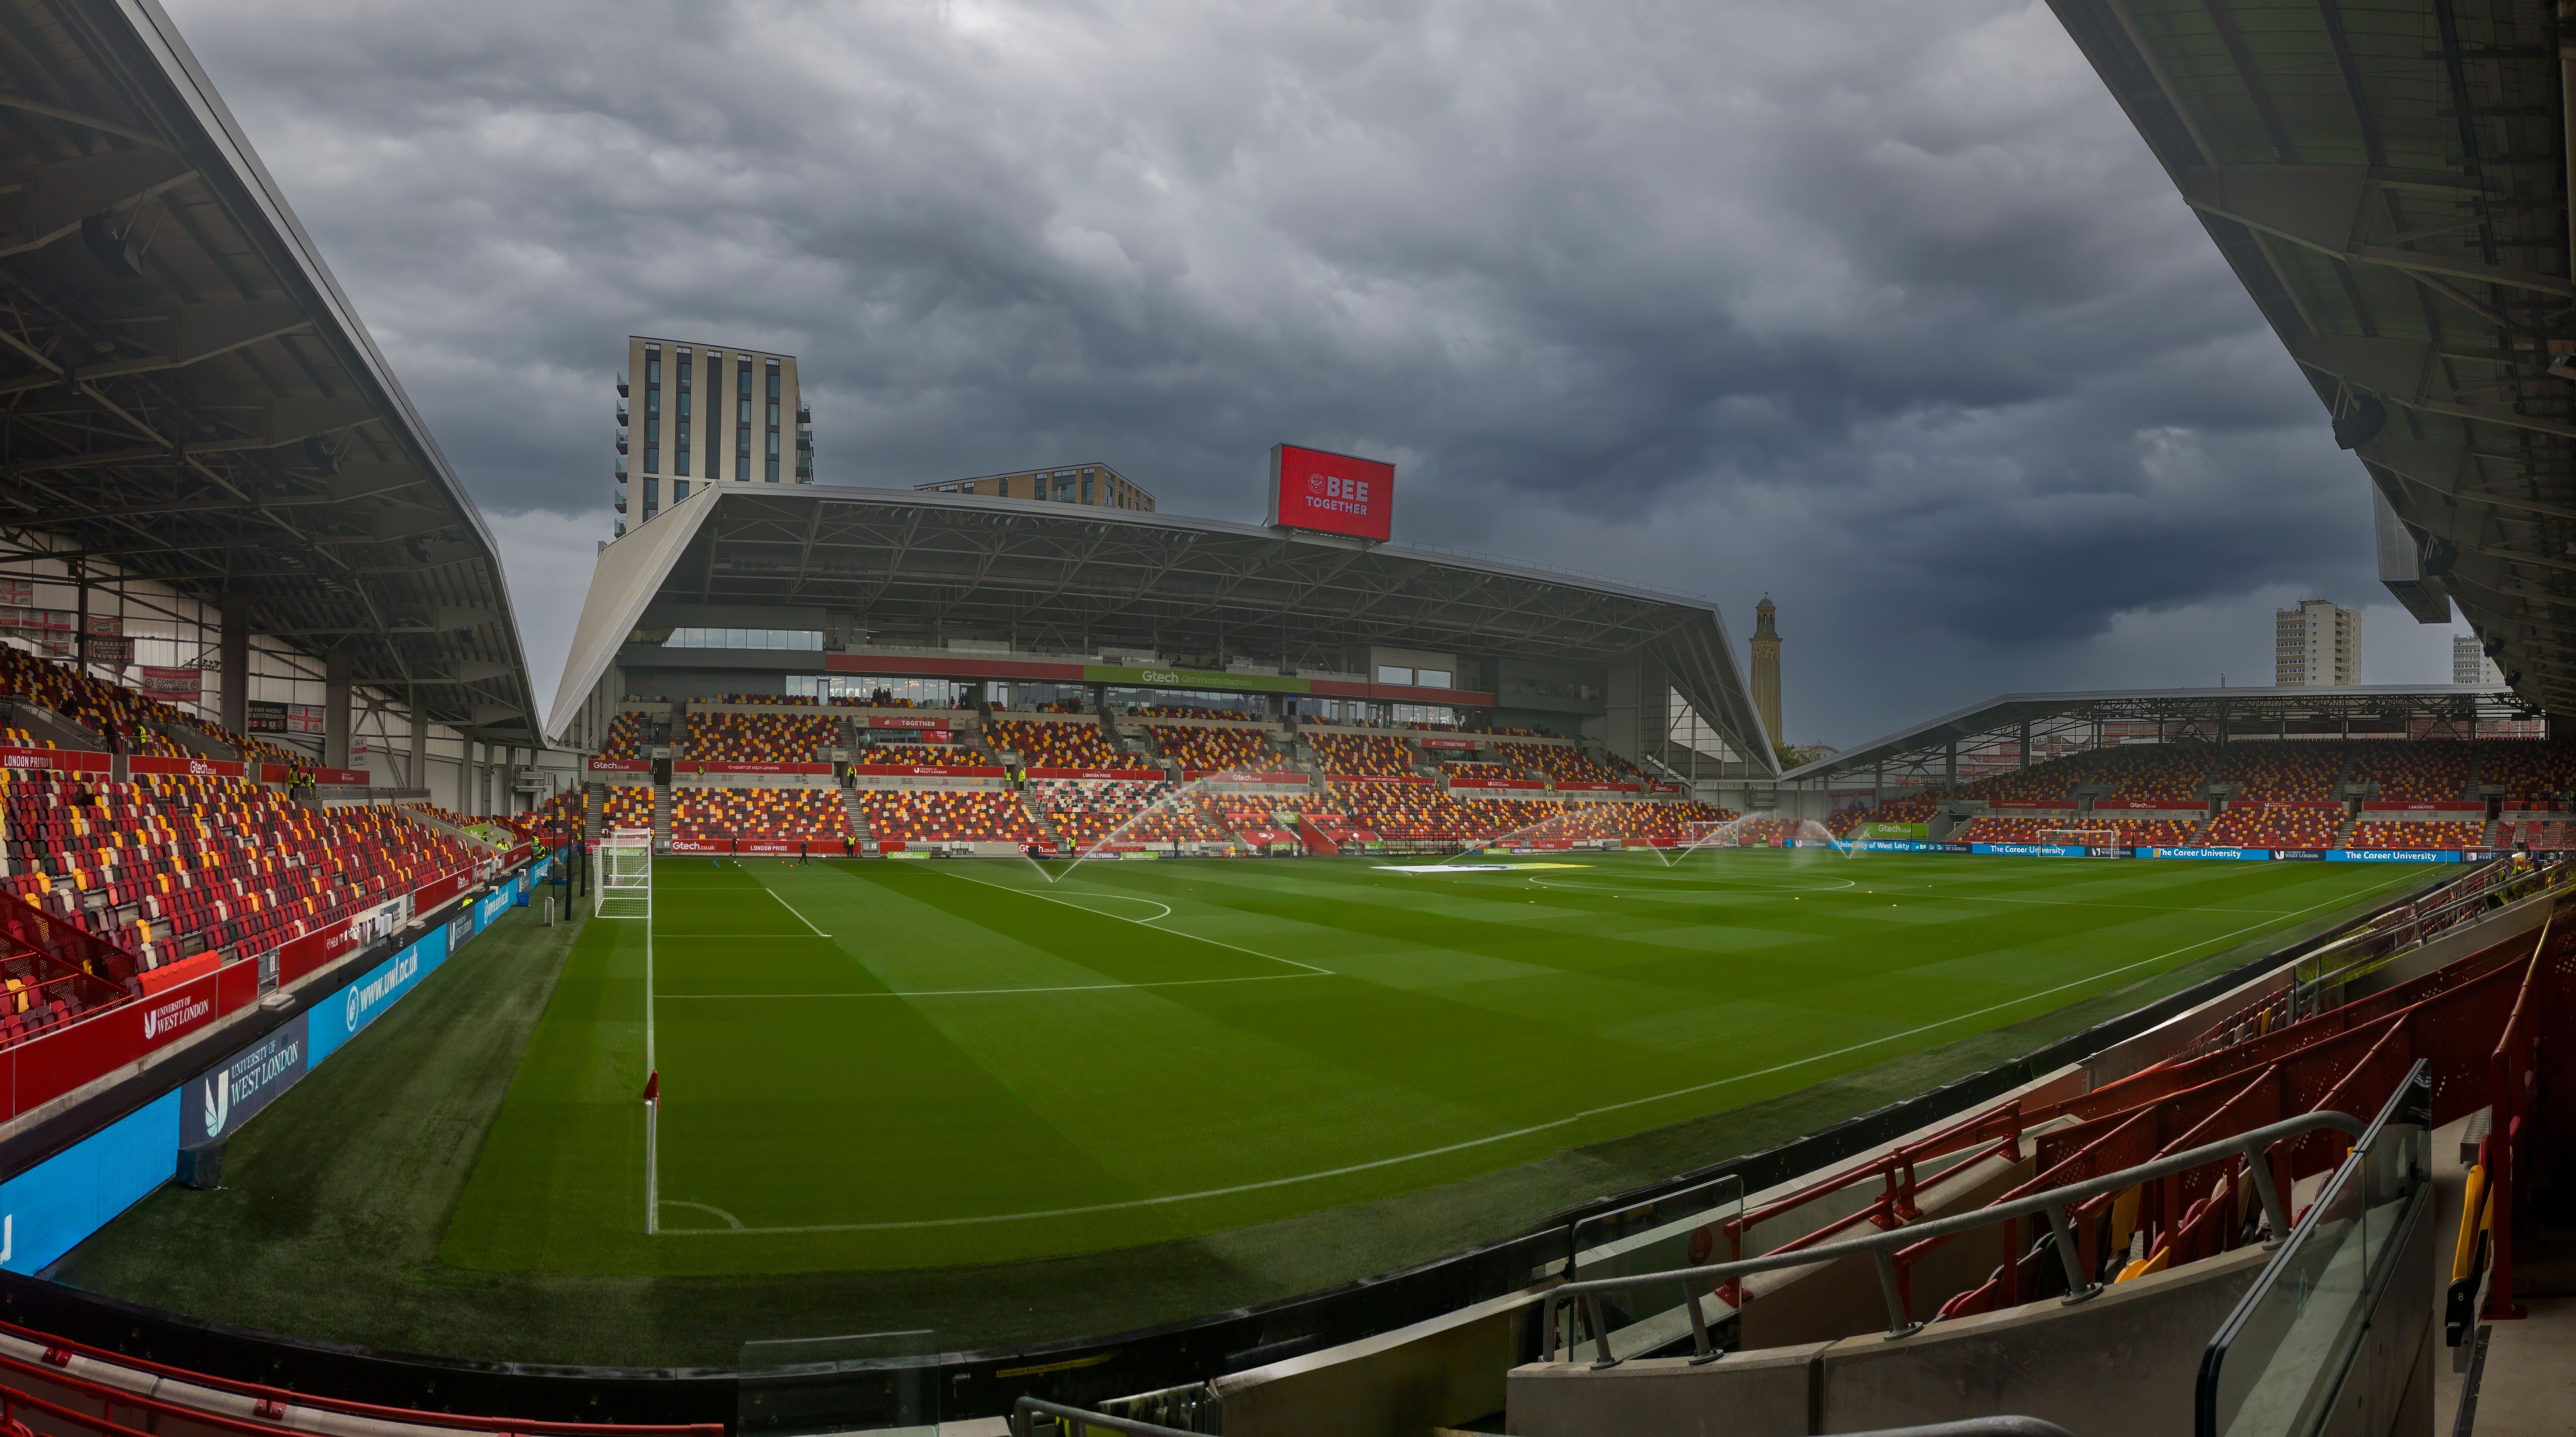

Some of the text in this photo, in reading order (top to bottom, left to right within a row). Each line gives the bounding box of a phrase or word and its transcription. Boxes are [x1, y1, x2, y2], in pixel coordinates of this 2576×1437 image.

[1327, 476, 1369, 502] BEE
[1306, 495, 1367, 515] TOGETHER
[1142, 670, 1178, 683] Gtech
[1182, 676, 1222, 685] Community
[4, 755, 29, 767] LONDON
[190, 760, 217, 774] Gtech.co.uk
[673, 841, 715, 851] Gtech.co.uk
[2201, 849, 2241, 859] University
[2393, 851, 2437, 861] University
[360, 945, 418, 1012] www.uwl.ac.uk
[157, 996, 191, 1018] UNIVERSITY OF
[157, 999, 209, 1035] WEST LONDON
[232, 1040, 276, 1079] UNIVERSITY OF
[231, 1040, 299, 1107] WEST LONDON
[2458, 1293, 2464, 1301] 8
